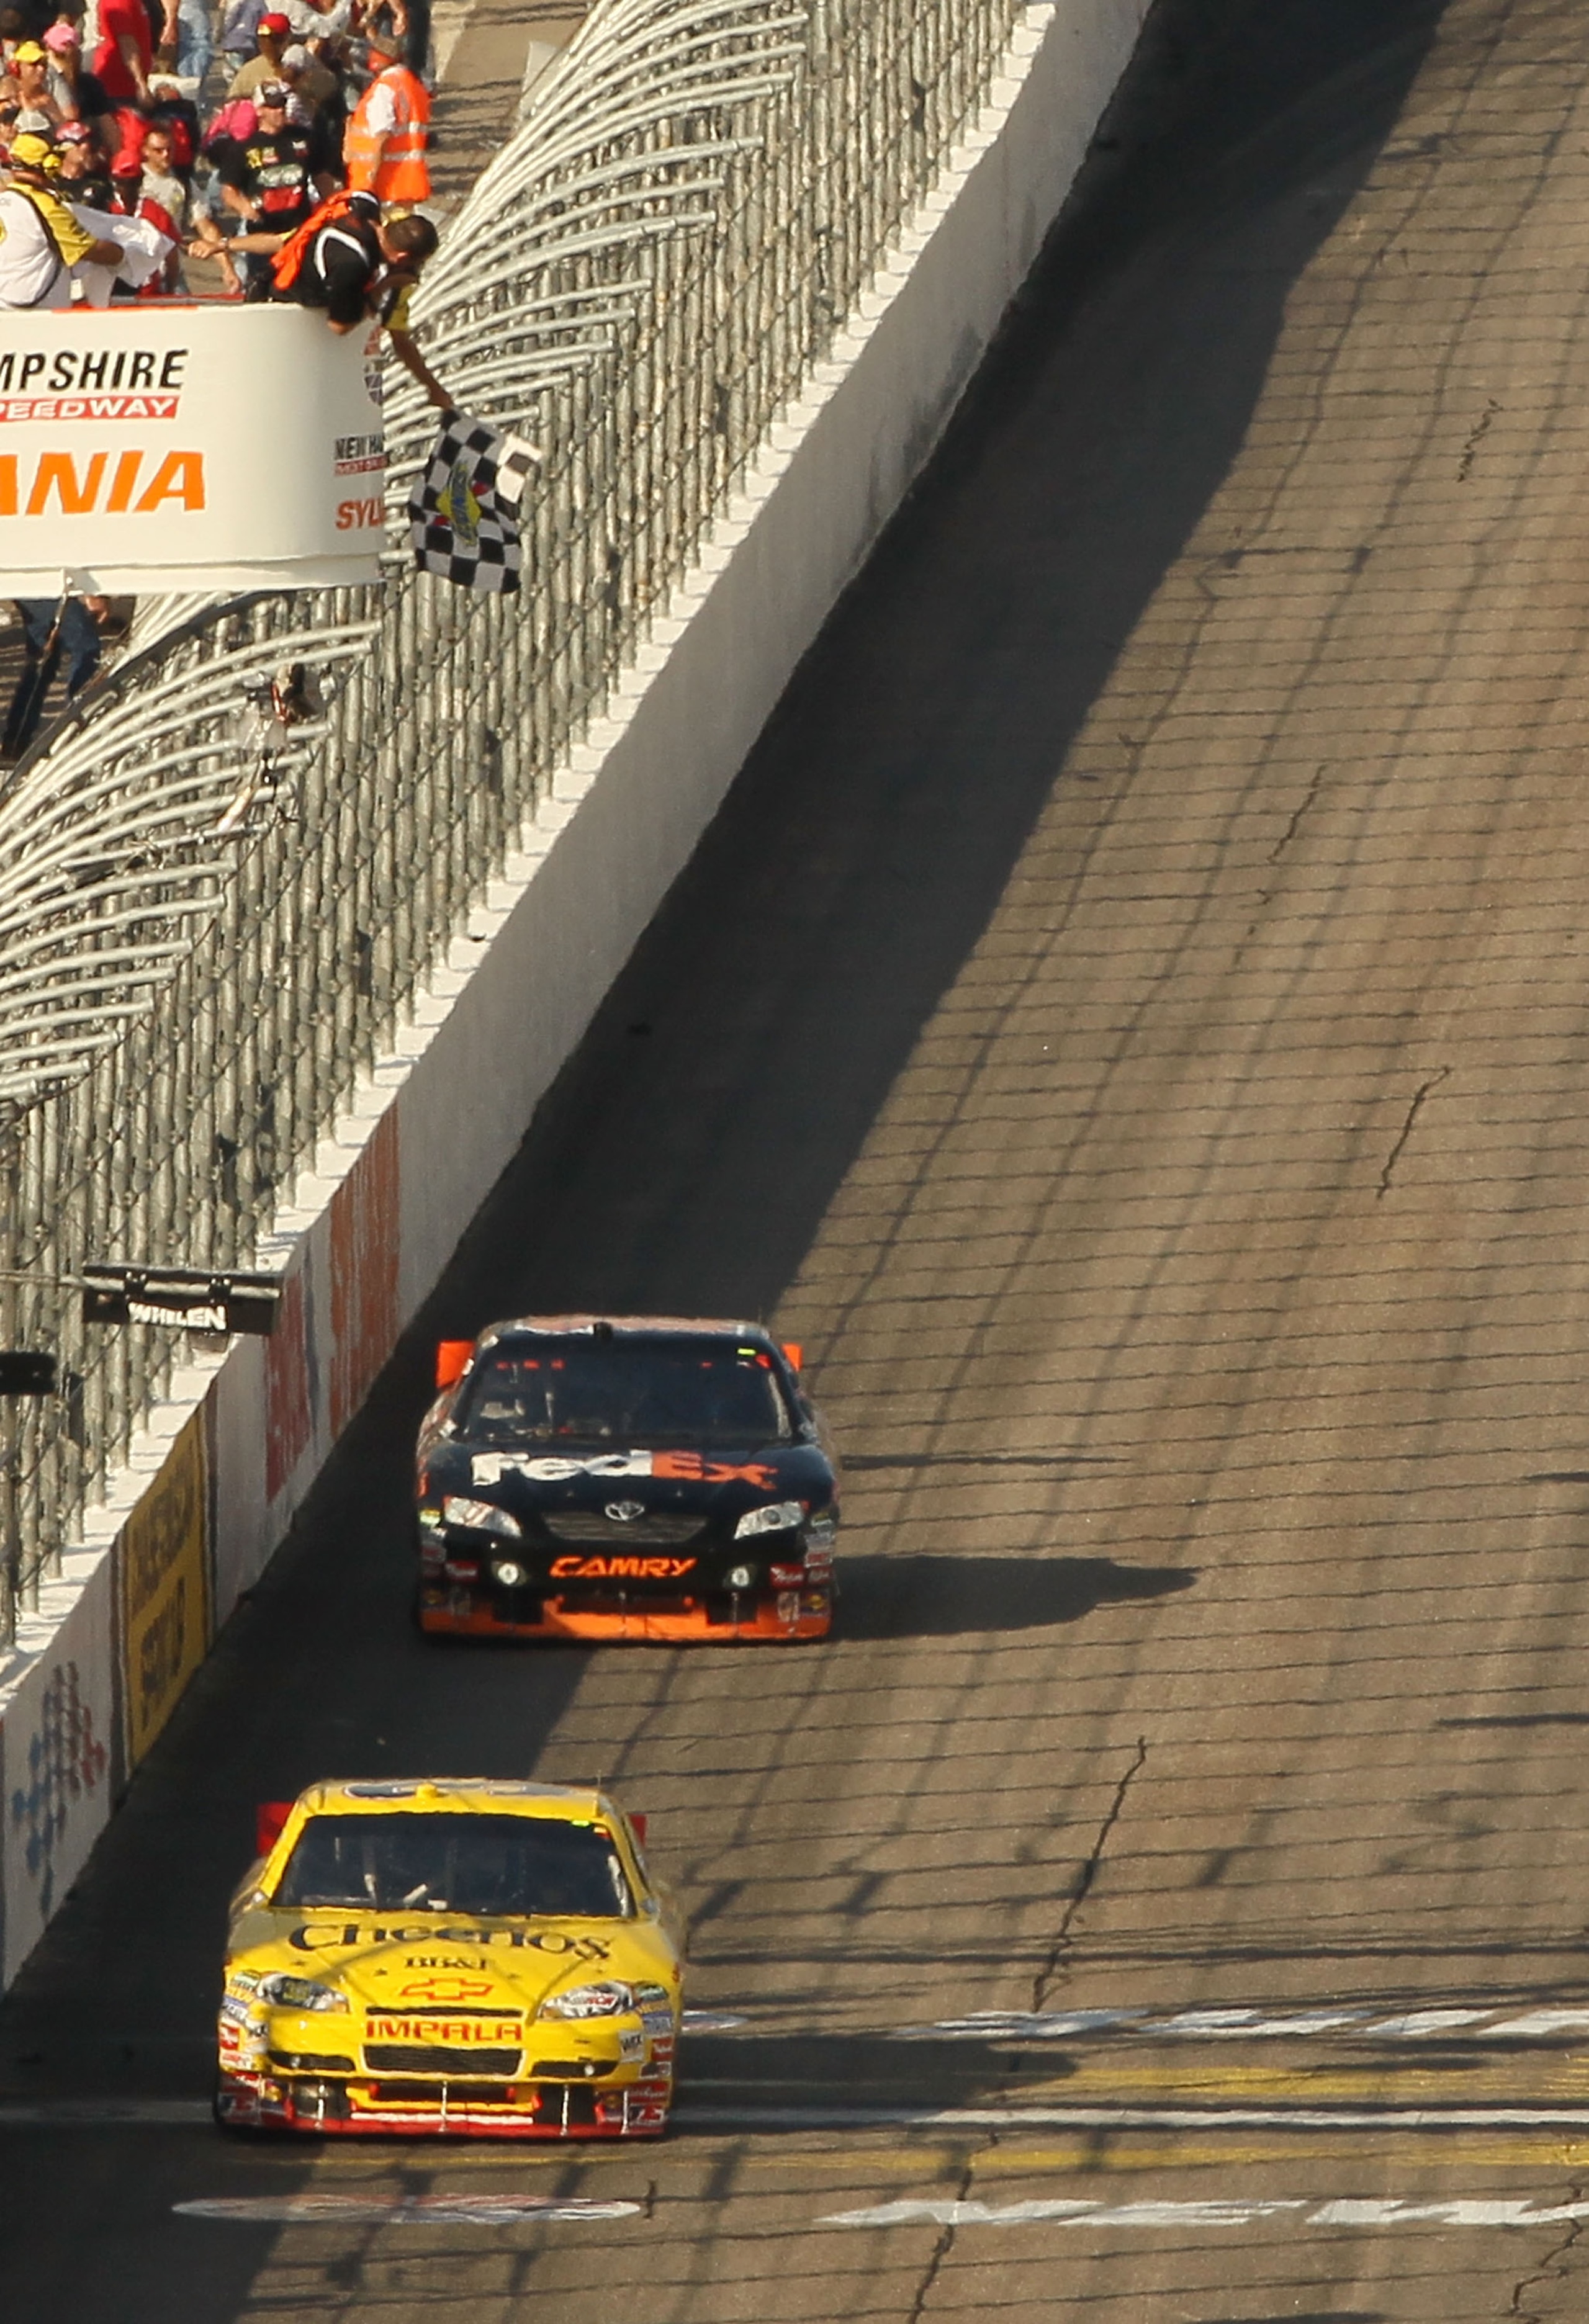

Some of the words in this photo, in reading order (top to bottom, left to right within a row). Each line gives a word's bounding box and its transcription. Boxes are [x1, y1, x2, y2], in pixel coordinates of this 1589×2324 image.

[0, 398, 174, 419] EEDWAY
[470, 1448, 778, 1490] FedEx
[549, 1556, 698, 1578] CAMRY
[366, 2019, 523, 2042] IMPALA
